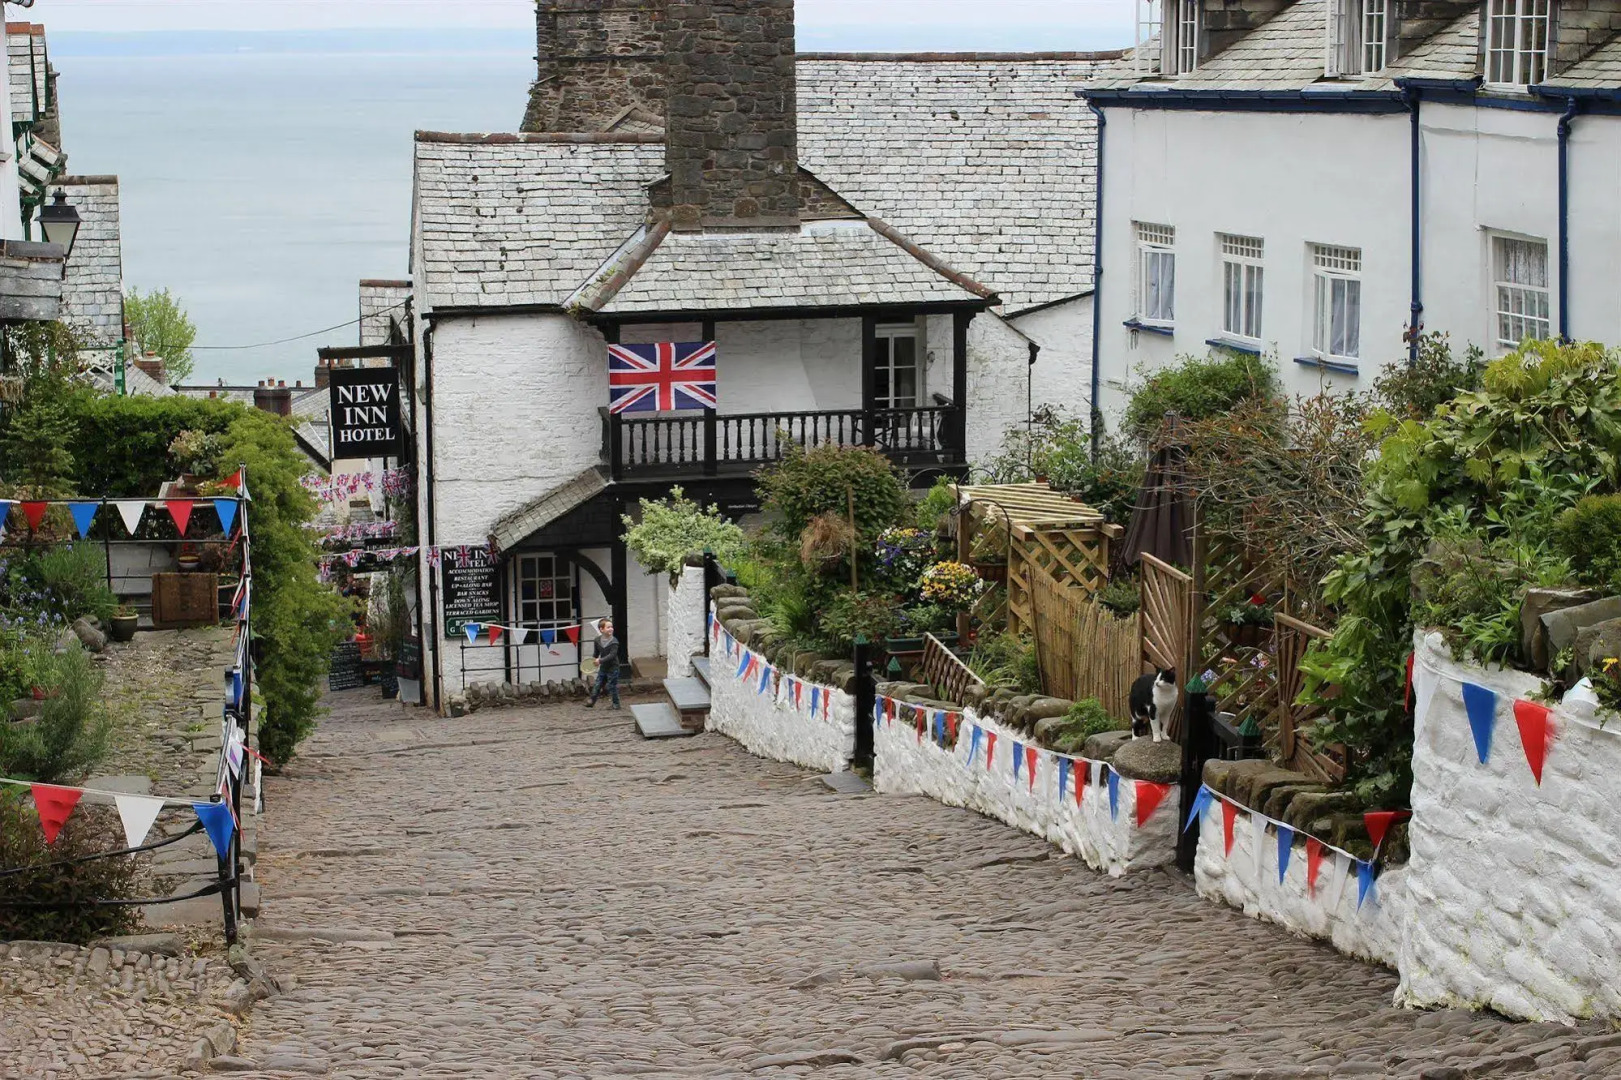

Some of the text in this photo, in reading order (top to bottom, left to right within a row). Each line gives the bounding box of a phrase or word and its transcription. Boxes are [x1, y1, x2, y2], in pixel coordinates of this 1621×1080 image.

[337, 384, 392, 404] NEW
[344, 406, 388, 426] INN
[340, 428, 396, 442] HOTEL
